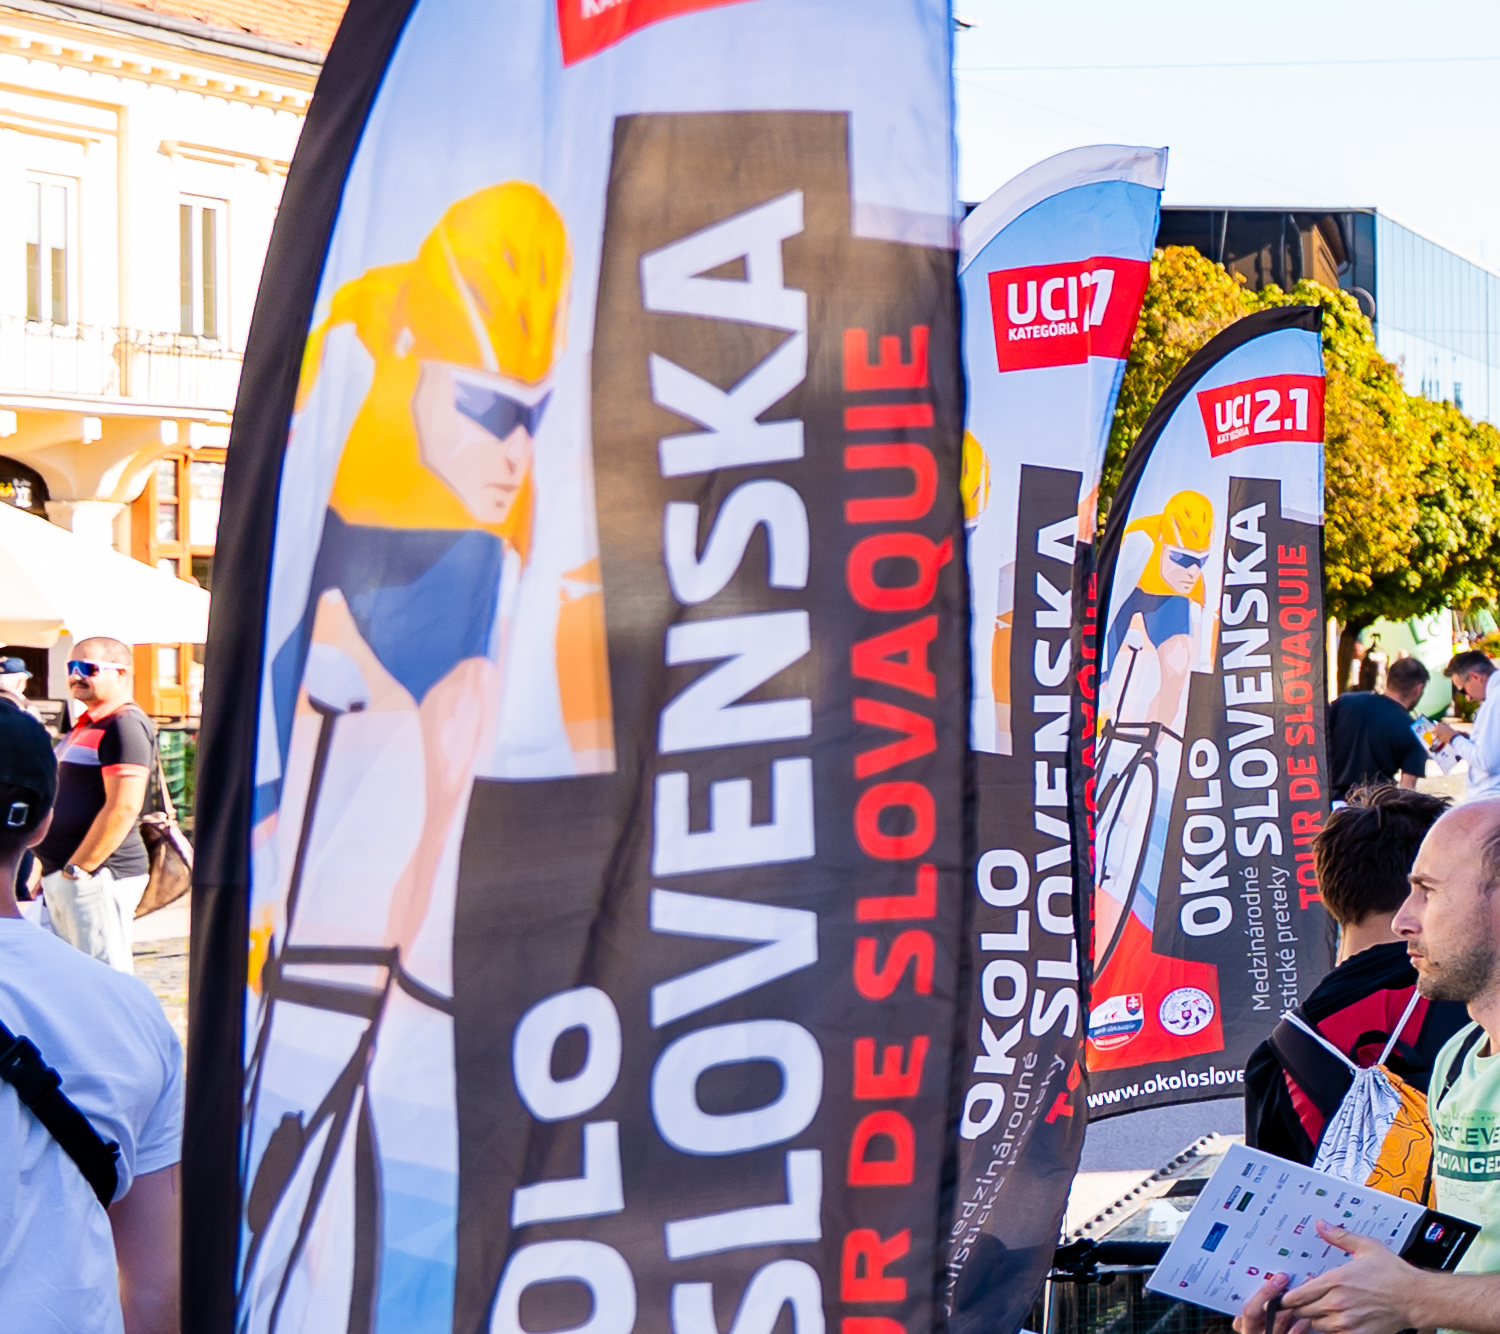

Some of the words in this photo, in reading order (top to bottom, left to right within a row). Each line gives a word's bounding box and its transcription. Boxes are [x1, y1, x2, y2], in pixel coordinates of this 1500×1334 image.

[1007, 275, 1078, 325] UCI
[1008, 322, 1078, 341] KATEGÓRIA
[1214, 394, 1251, 432] UCI
[1253, 388, 1308, 434] 2.1
[842, 324, 954, 1000] SLOVAQUIE
[1220, 503, 1284, 858] SLOVENSKA
[1278, 544, 1316, 745] SLOVAQUIE
[1180, 737, 1233, 937] OKOLO
[1288, 752, 1319, 802] DE
[1267, 865, 1297, 945] preteky
[1290, 809, 1321, 910] TOUR
[959, 849, 1030, 1140] OKOLO
[1240, 866, 1271, 1012] Medzinárodné
[847, 1034, 930, 1187] DE
